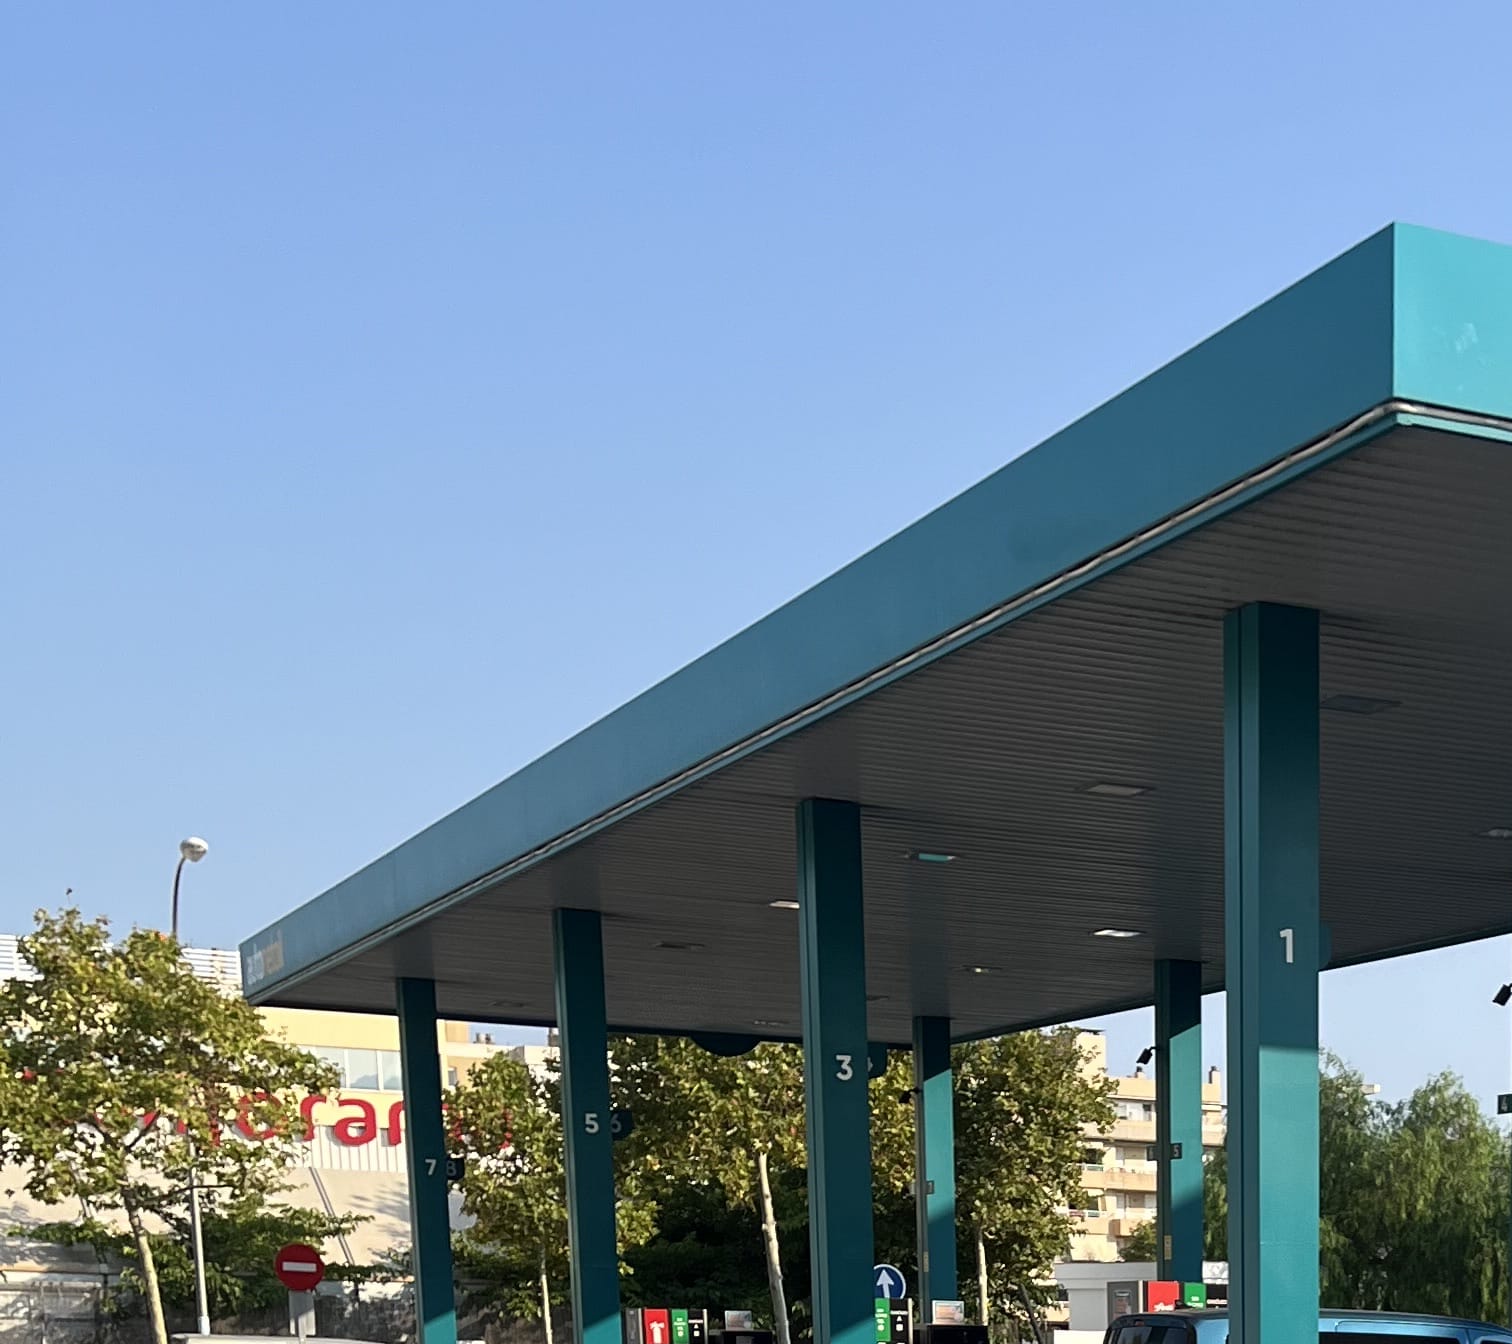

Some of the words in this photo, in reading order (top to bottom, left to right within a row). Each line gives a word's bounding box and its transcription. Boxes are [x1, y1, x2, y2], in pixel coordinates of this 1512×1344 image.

[1280, 928, 1294, 963] 1
[835, 1054, 853, 1081] 3
[585, 1113, 599, 1134] 5
[610, 1113, 622, 1133] 6
[425, 1158, 437, 1176] 7
